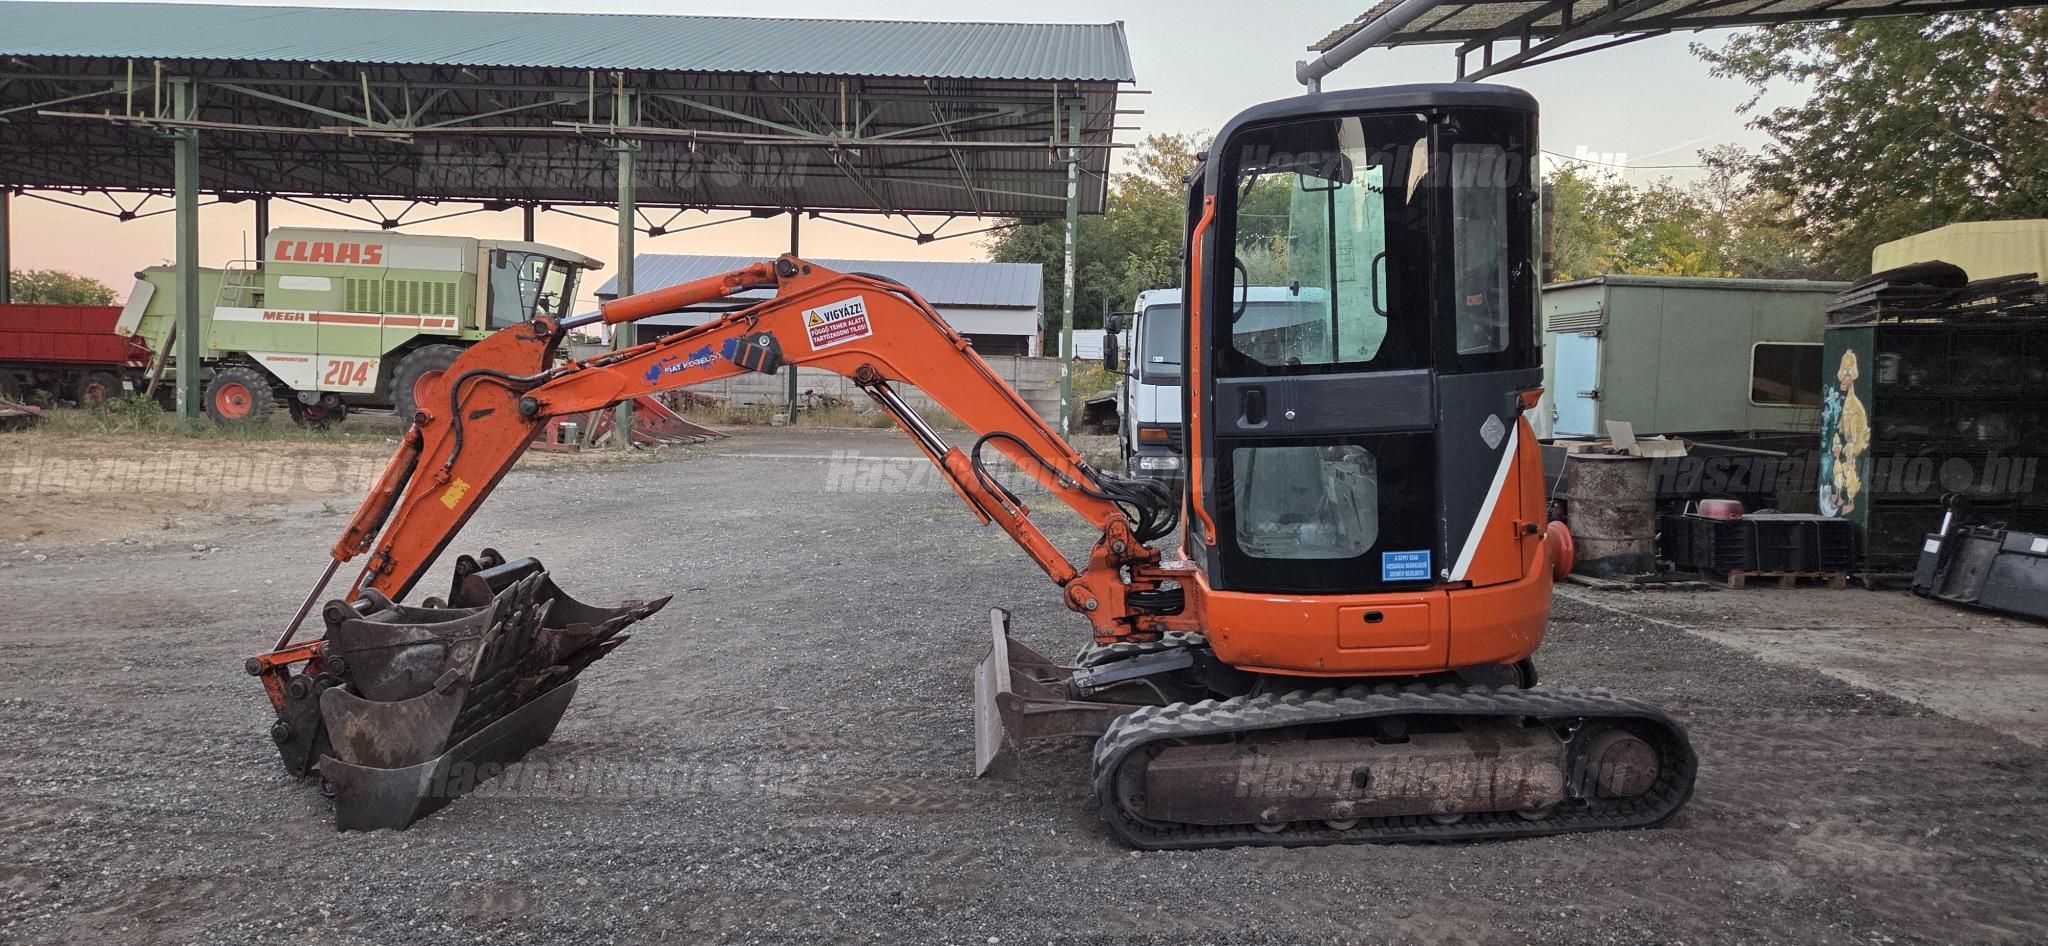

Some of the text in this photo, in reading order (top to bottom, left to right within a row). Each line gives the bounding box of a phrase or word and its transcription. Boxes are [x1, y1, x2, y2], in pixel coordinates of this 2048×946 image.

[274, 240, 384, 265] CLAAS
[262, 311, 305, 322] MEGA
[824, 303, 863, 321] VIGYÁZZ!
[829, 322, 848, 332] TEHER
[848, 316, 865, 326] ALATT
[323, 359, 369, 387] 204
